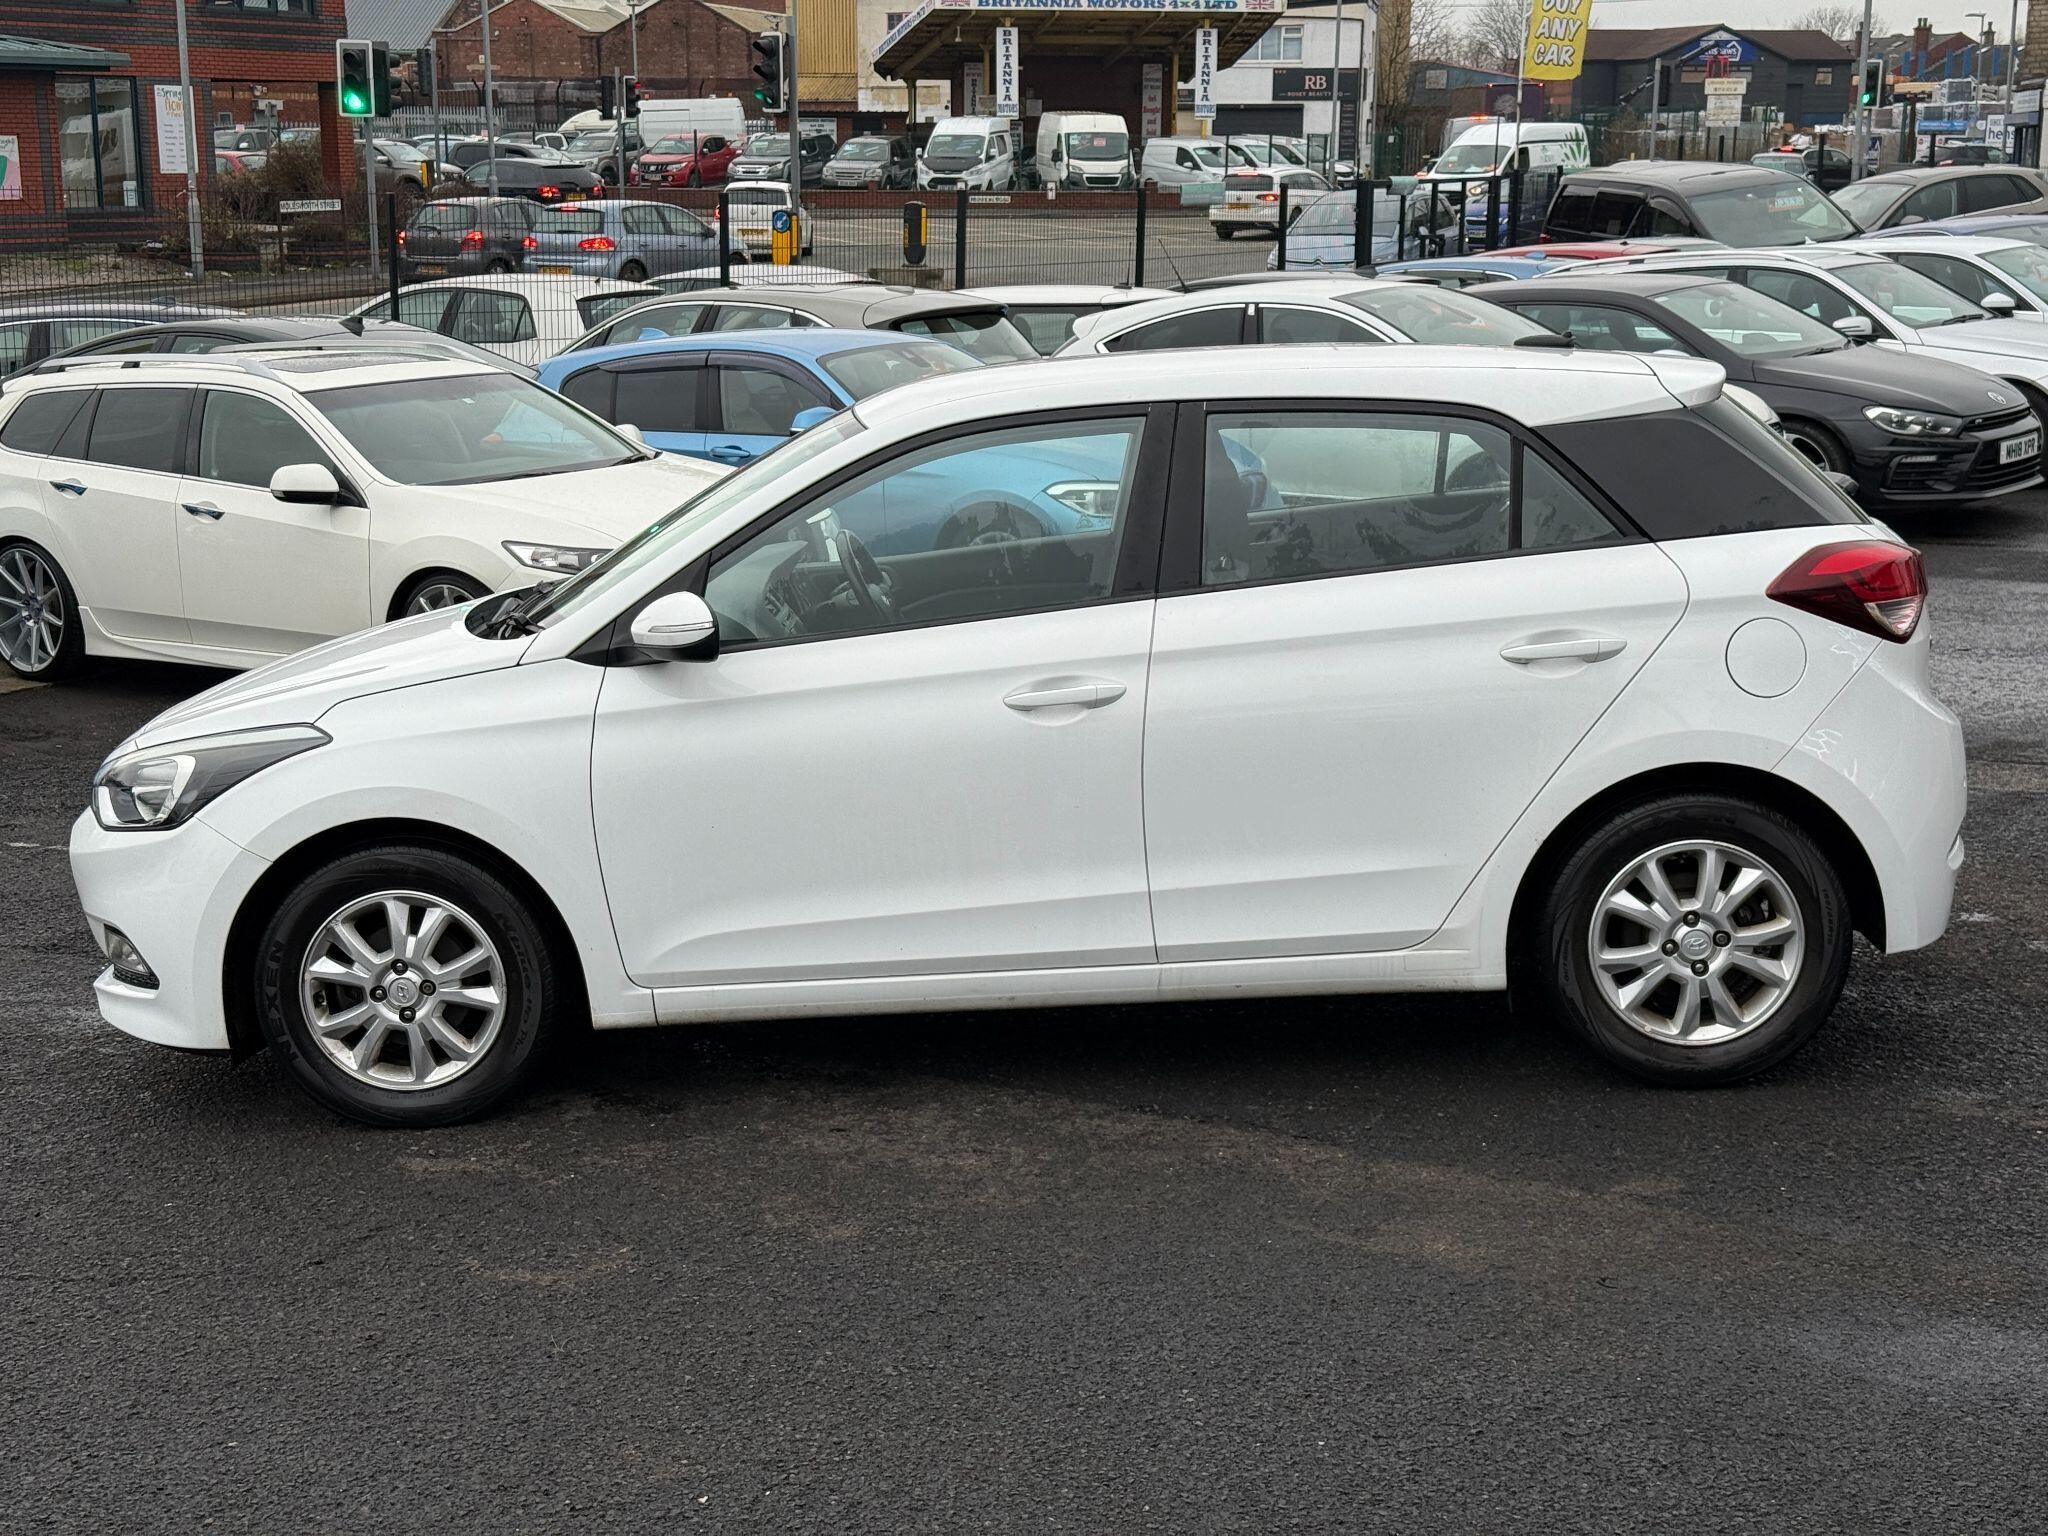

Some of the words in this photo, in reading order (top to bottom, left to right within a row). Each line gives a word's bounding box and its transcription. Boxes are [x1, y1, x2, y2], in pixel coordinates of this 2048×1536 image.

[977, 0, 1083, 8] BRITANNIA
[1086, 0, 1166, 9] MOTORS
[1203, 0, 1238, 9] LTD
[1534, 16, 1583, 42] ANY
[1533, 42, 1575, 67] CAR
[1002, 29, 1012, 101] BRITANNIA
[1200, 30, 1212, 101] BRITANNIA
[1304, 75, 1327, 90] RB
[997, 103, 1018, 114] MOTORS
[1195, 104, 1215, 113] MOTORS
[1987, 127, 2015, 140] hens
